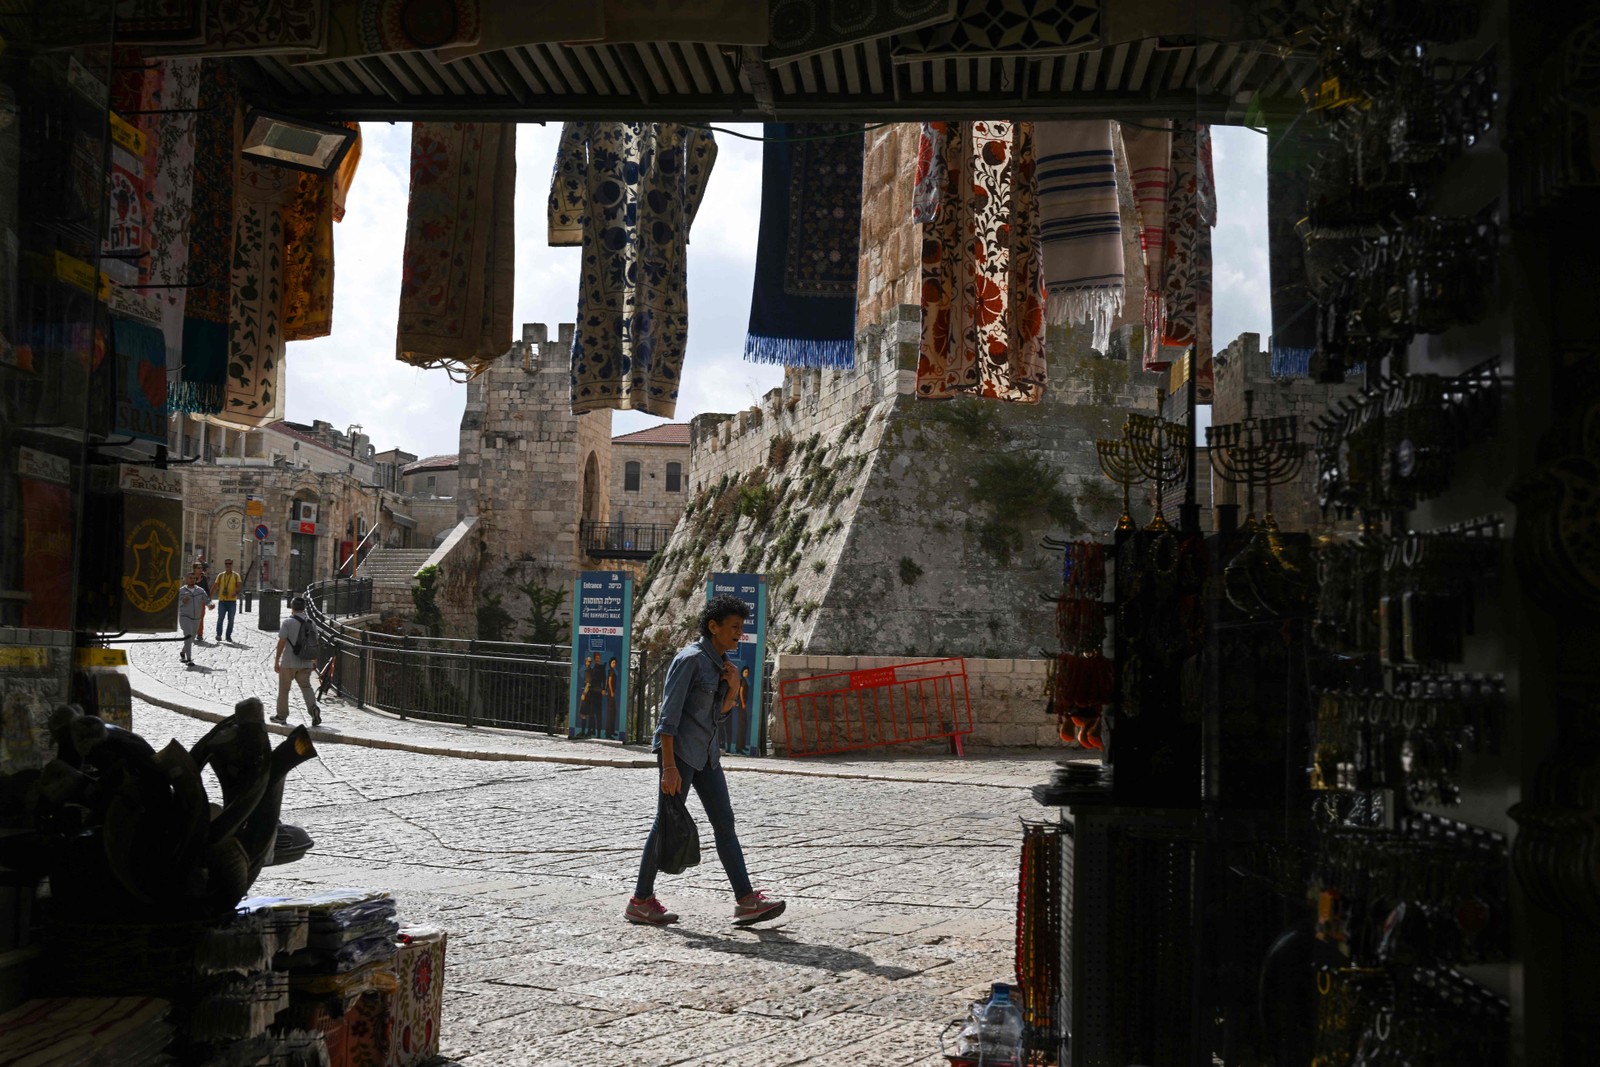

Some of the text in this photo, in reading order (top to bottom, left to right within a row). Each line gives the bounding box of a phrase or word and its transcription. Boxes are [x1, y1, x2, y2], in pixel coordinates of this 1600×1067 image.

[129, 479, 182, 494] JERUSALEM
[715, 584, 736, 592] Entrance
[583, 596, 622, 605] טיילת החומות
